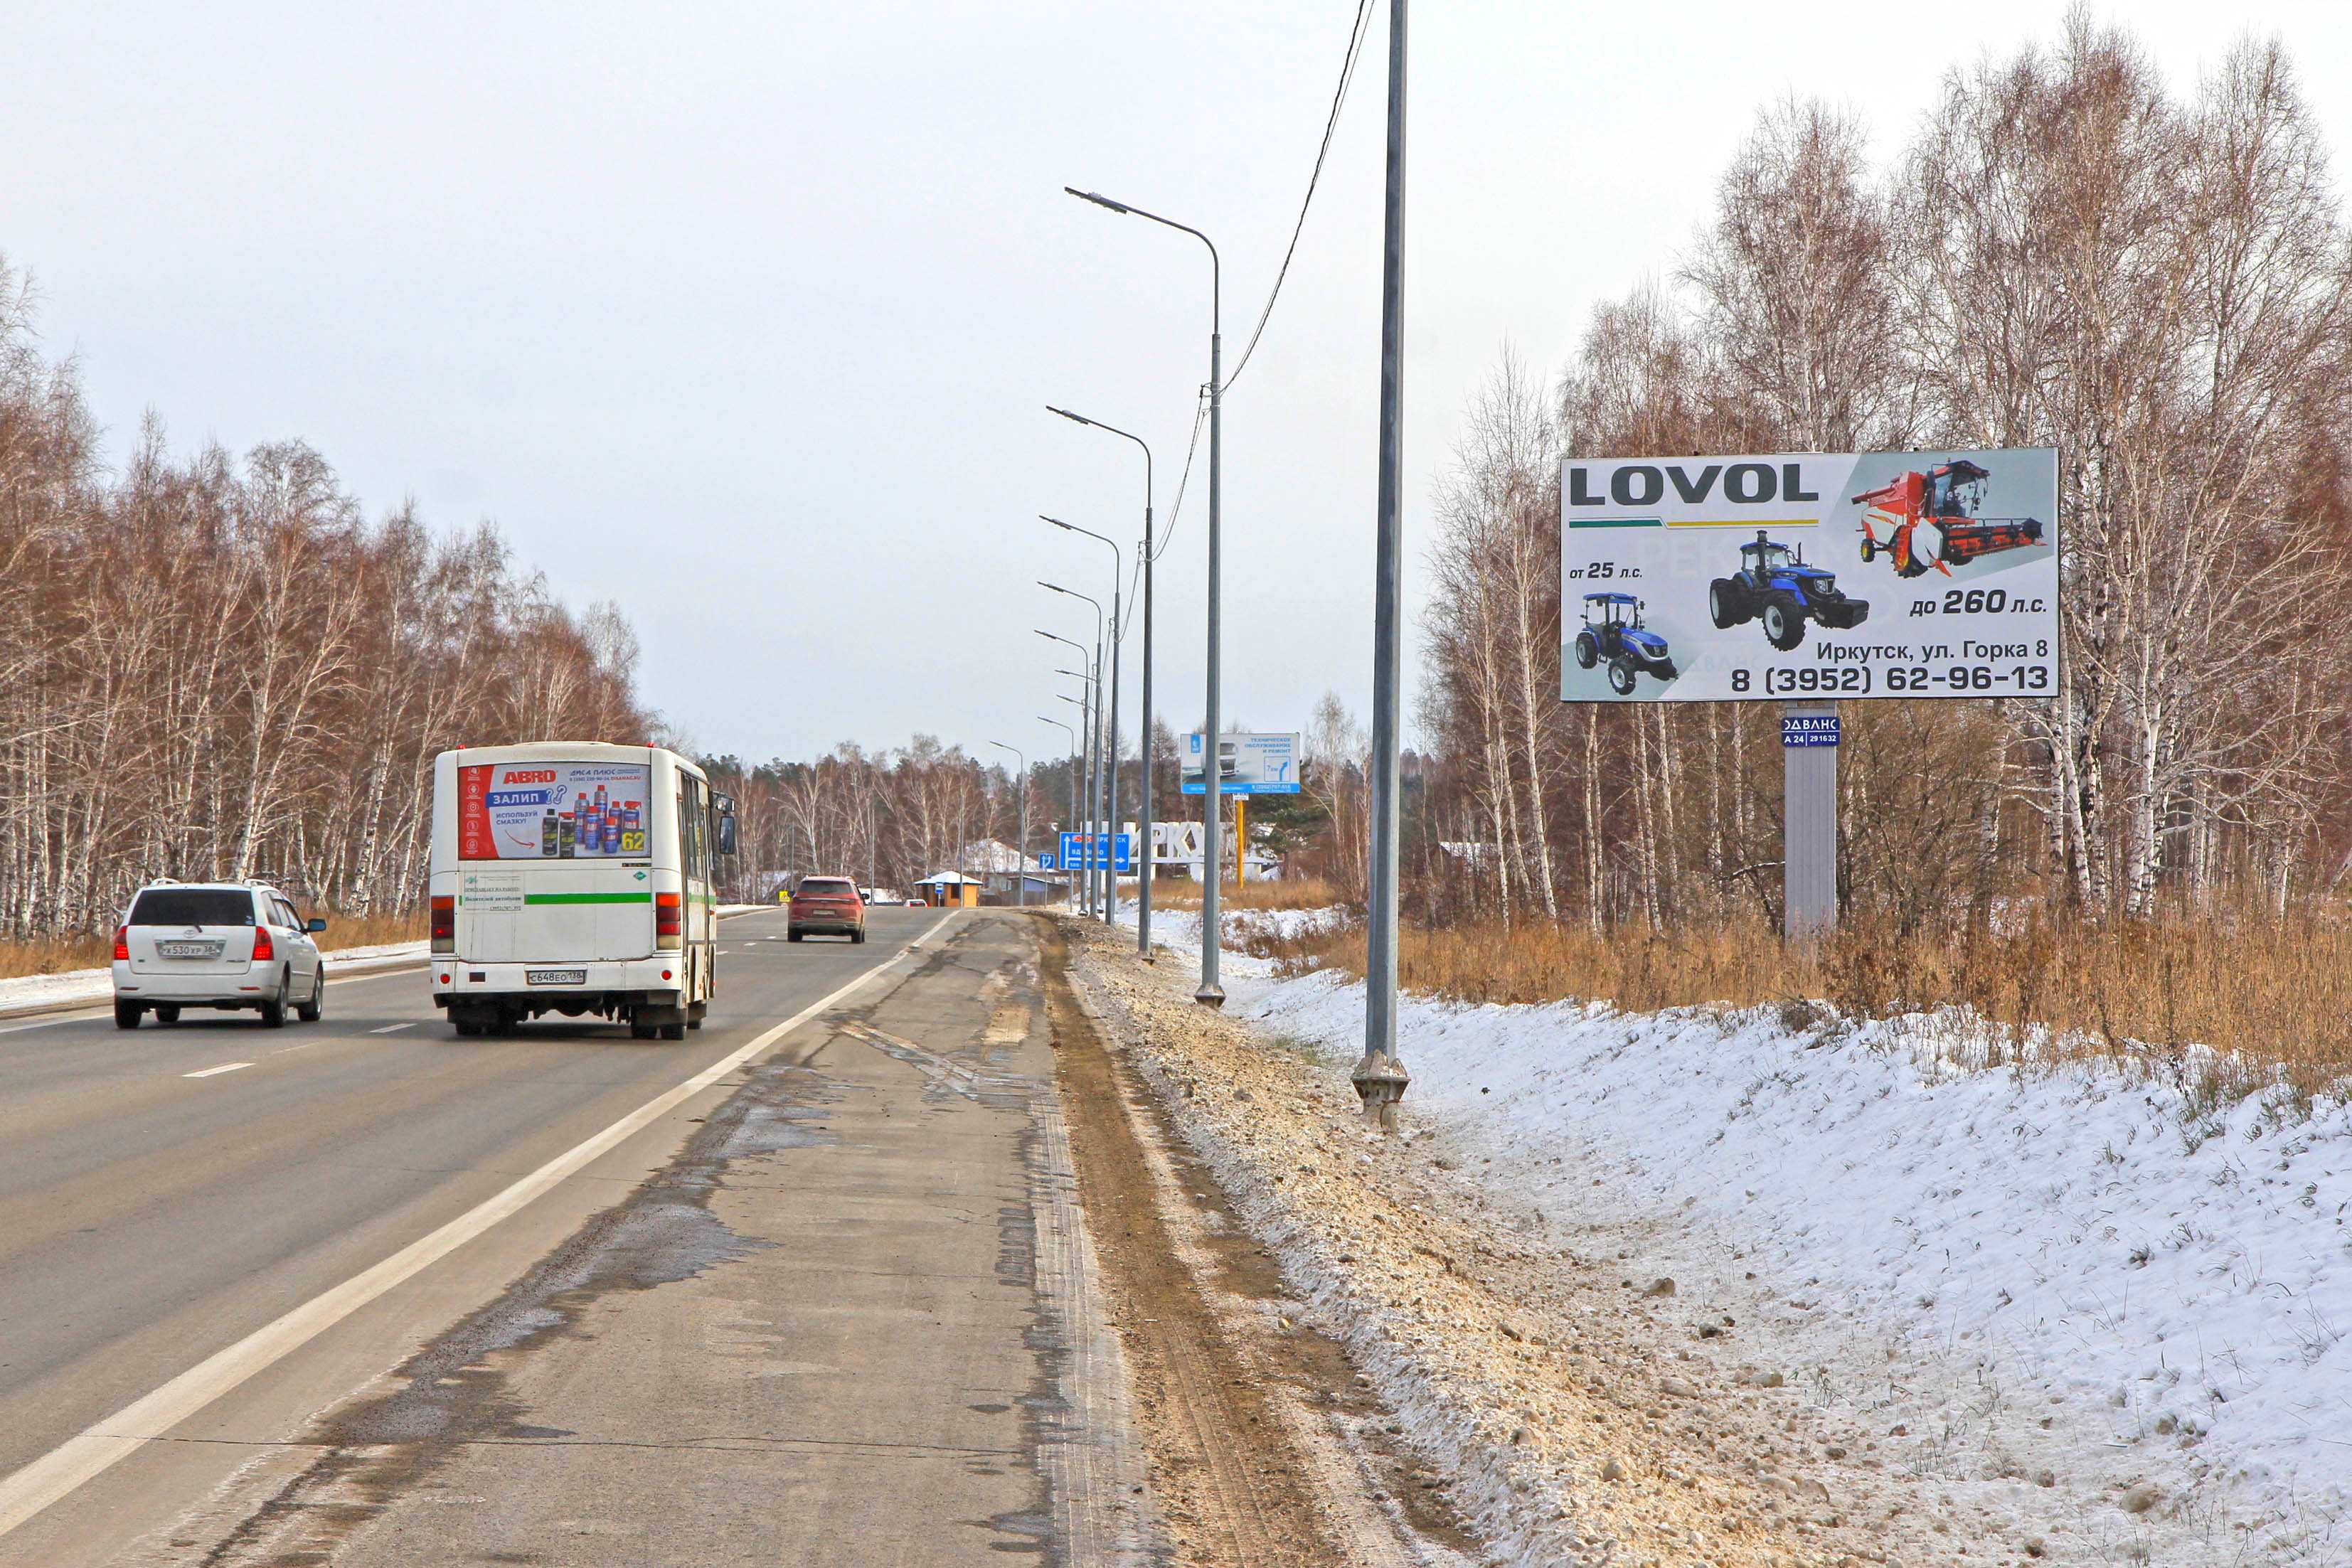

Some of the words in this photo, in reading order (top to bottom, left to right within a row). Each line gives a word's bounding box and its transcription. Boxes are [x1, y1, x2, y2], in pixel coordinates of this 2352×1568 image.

[1570, 464, 1819, 506] LOVOL
[1570, 570, 1584, 578] от
[1587, 562, 1614, 578] 25
[1619, 568, 1643, 578] л.с.
[1910, 600, 1936, 617] до
[1943, 590, 2006, 614] 260
[2011, 599, 2047, 613] л.с.
[1817, 642, 1914, 663] Иркутск,
[1922, 645, 1954, 662] ул.
[1964, 641, 2028, 662] Горка
[2036, 640, 2048, 657] 8
[1732, 669, 1750, 692] 8
[1766, 666, 1871, 695] (3952)
[1887, 666, 2048, 690] 62-96-13
[503, 770, 557, 784] ABRO
[496, 810, 538, 818] ИСПОЛЬЗУЙ
[622, 832, 645, 851] 62
